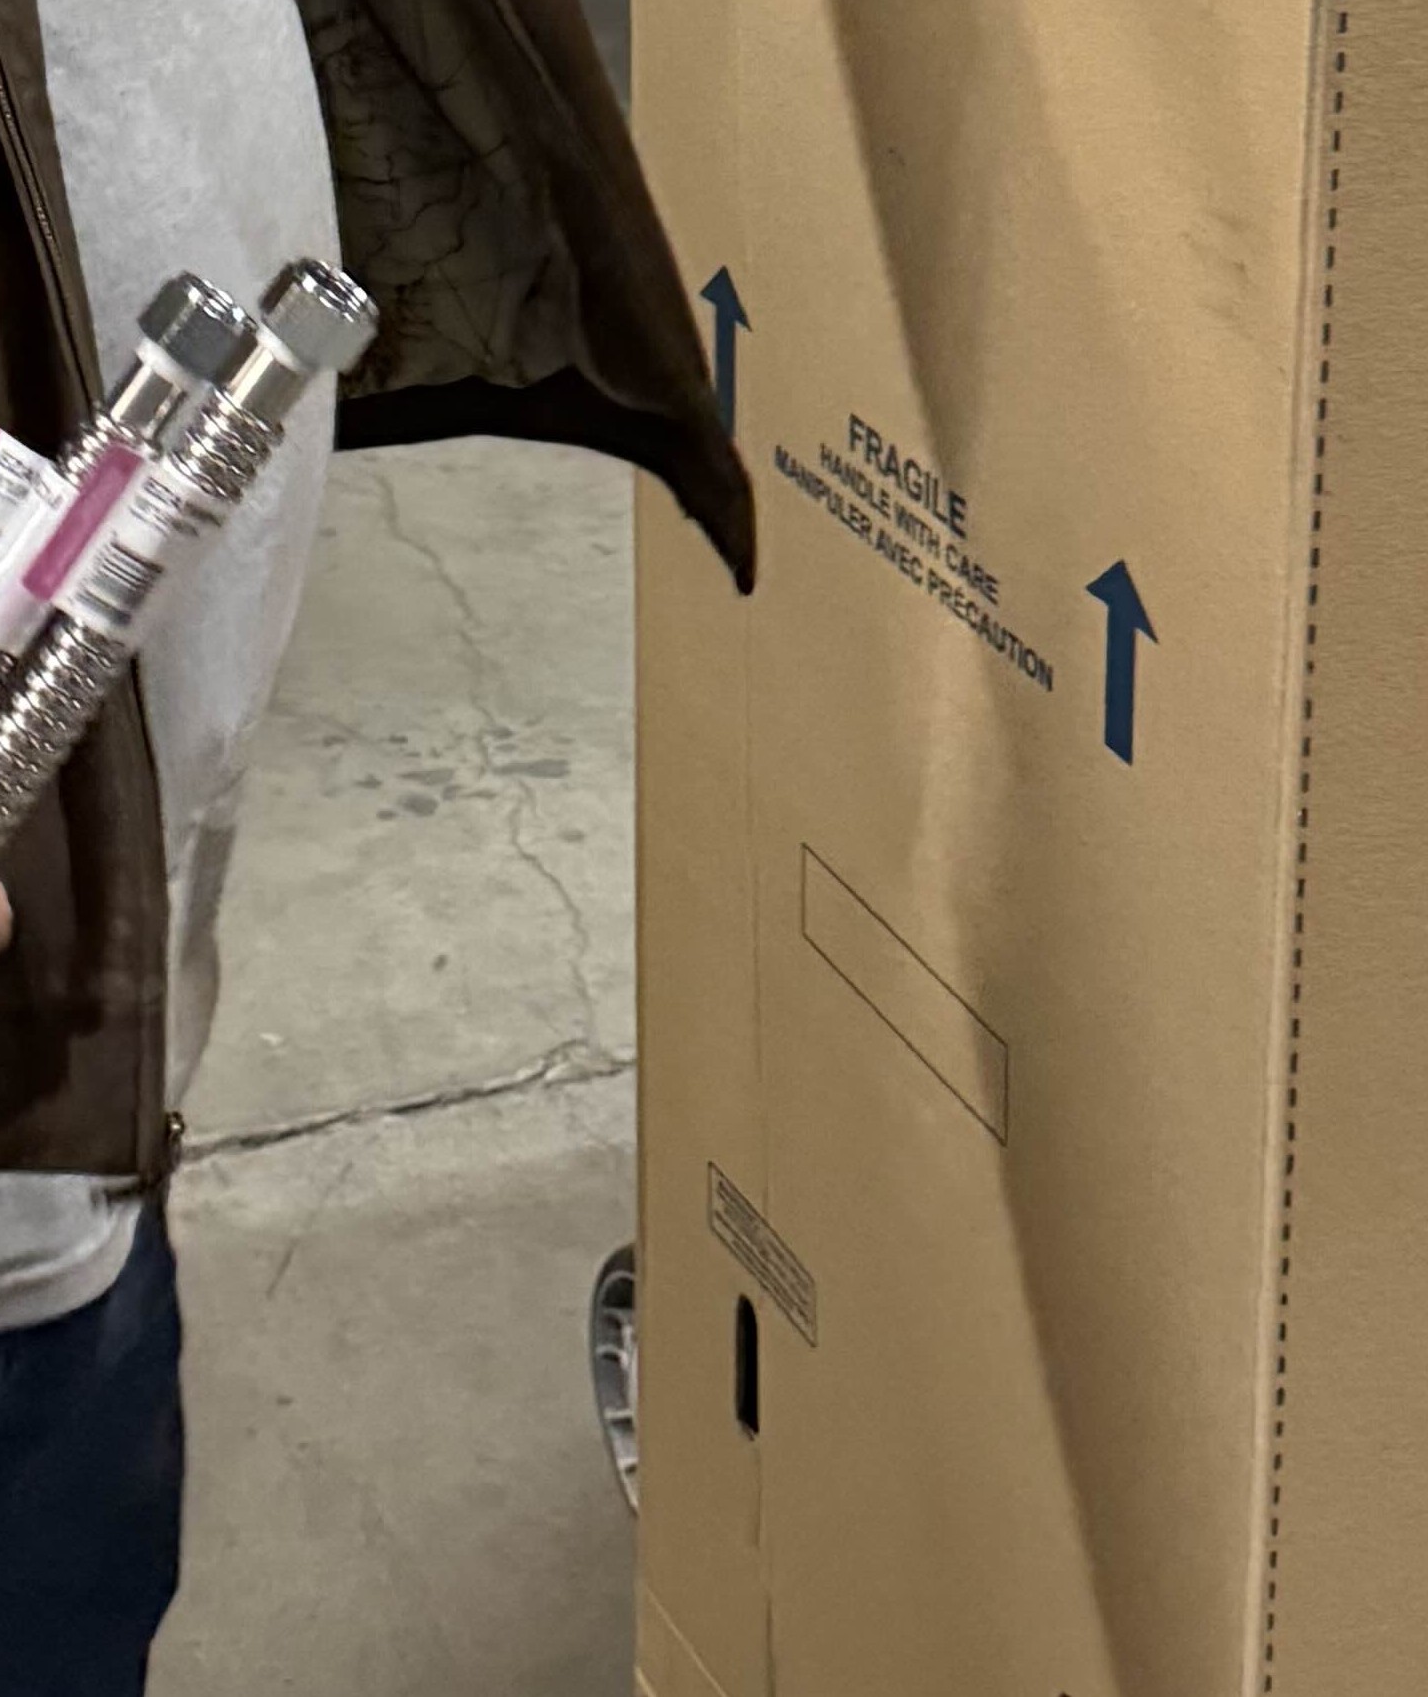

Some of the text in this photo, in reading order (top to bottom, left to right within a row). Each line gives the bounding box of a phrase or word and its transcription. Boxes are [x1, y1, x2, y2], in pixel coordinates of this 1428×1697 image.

[820, 442, 1000, 606] HANDLE WITH CARE
[848, 412, 967, 541] FRAGILE
[775, 444, 1053, 693] MANIPULER AVEC PRÉCAUTION
